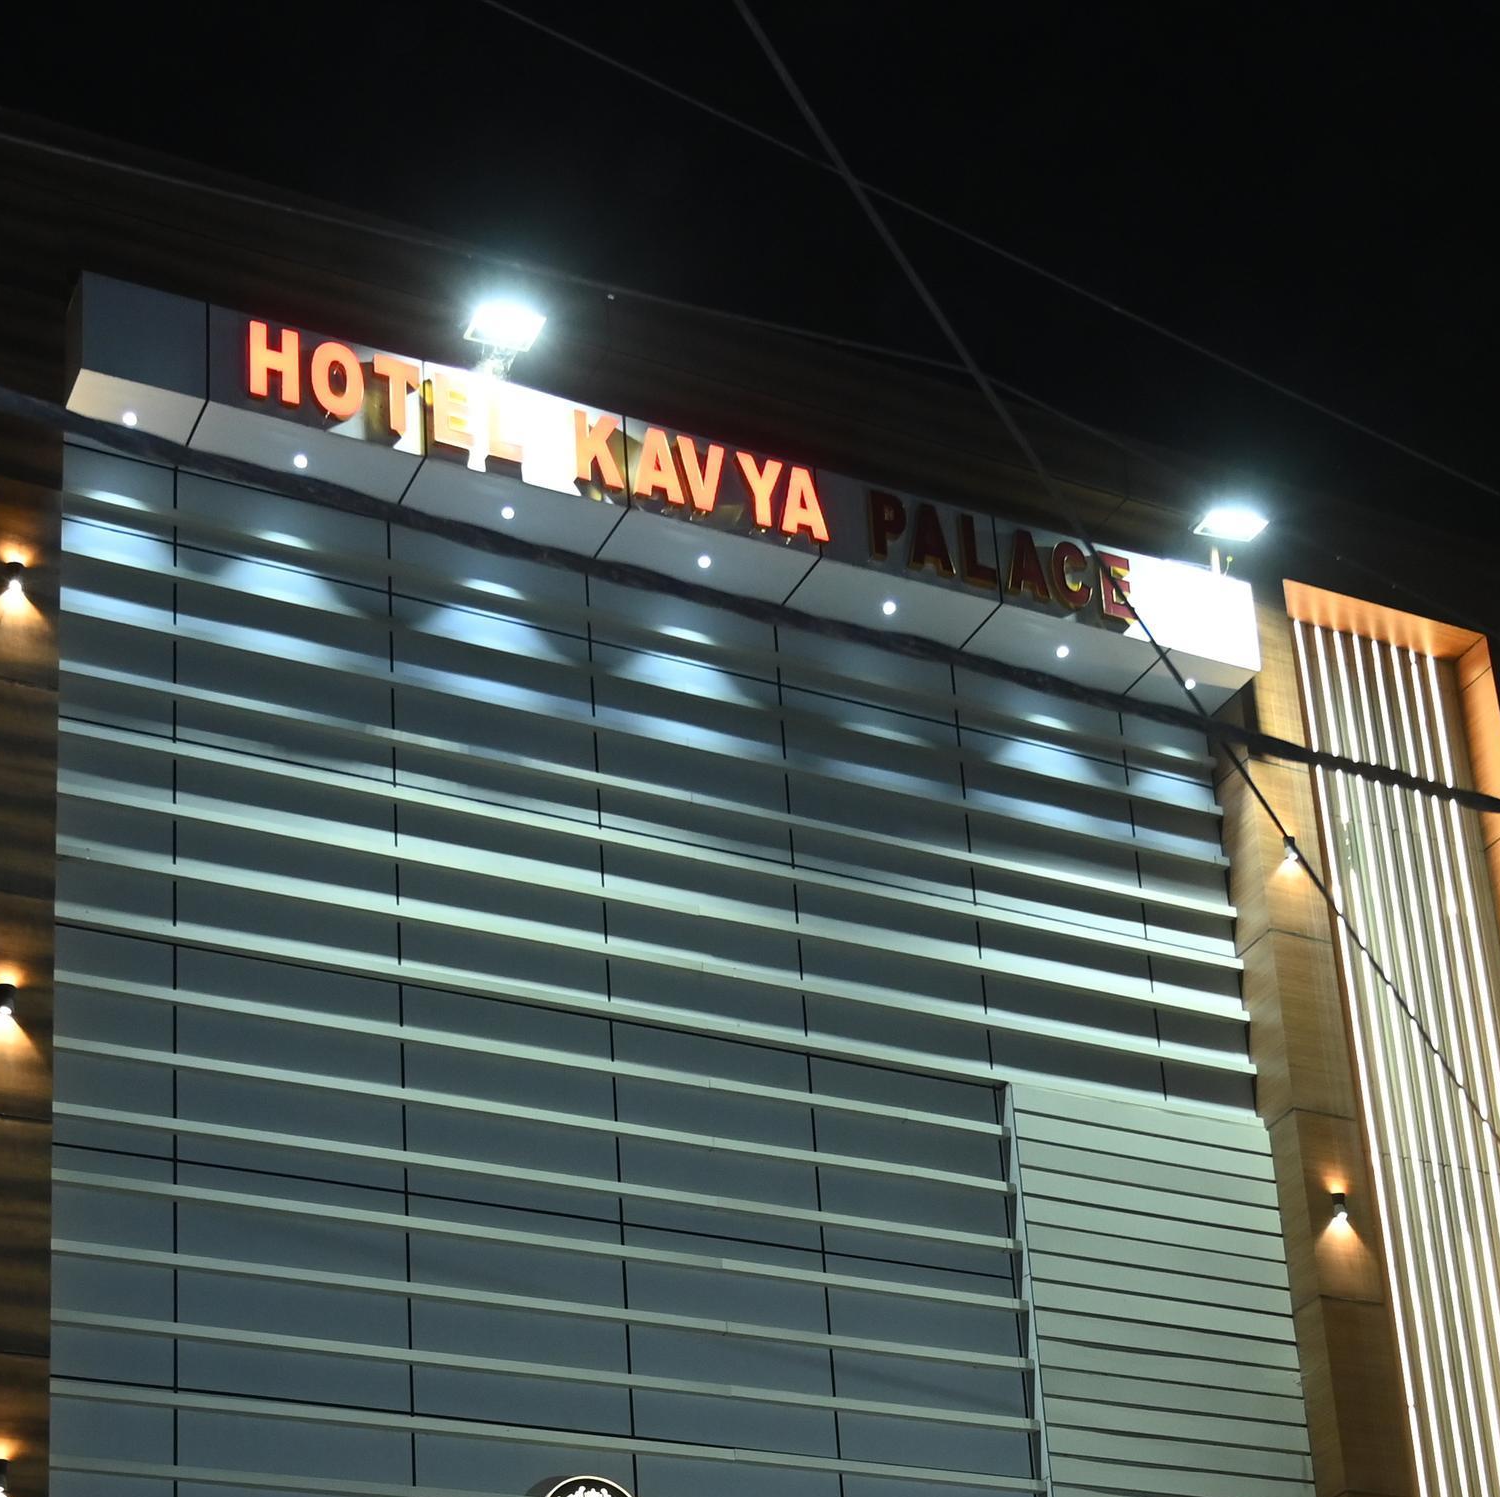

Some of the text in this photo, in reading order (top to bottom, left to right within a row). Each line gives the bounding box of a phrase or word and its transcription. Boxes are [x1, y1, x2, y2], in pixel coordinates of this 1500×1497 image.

[248, 320, 1138, 624] HOTEL KAVYA PALACE
